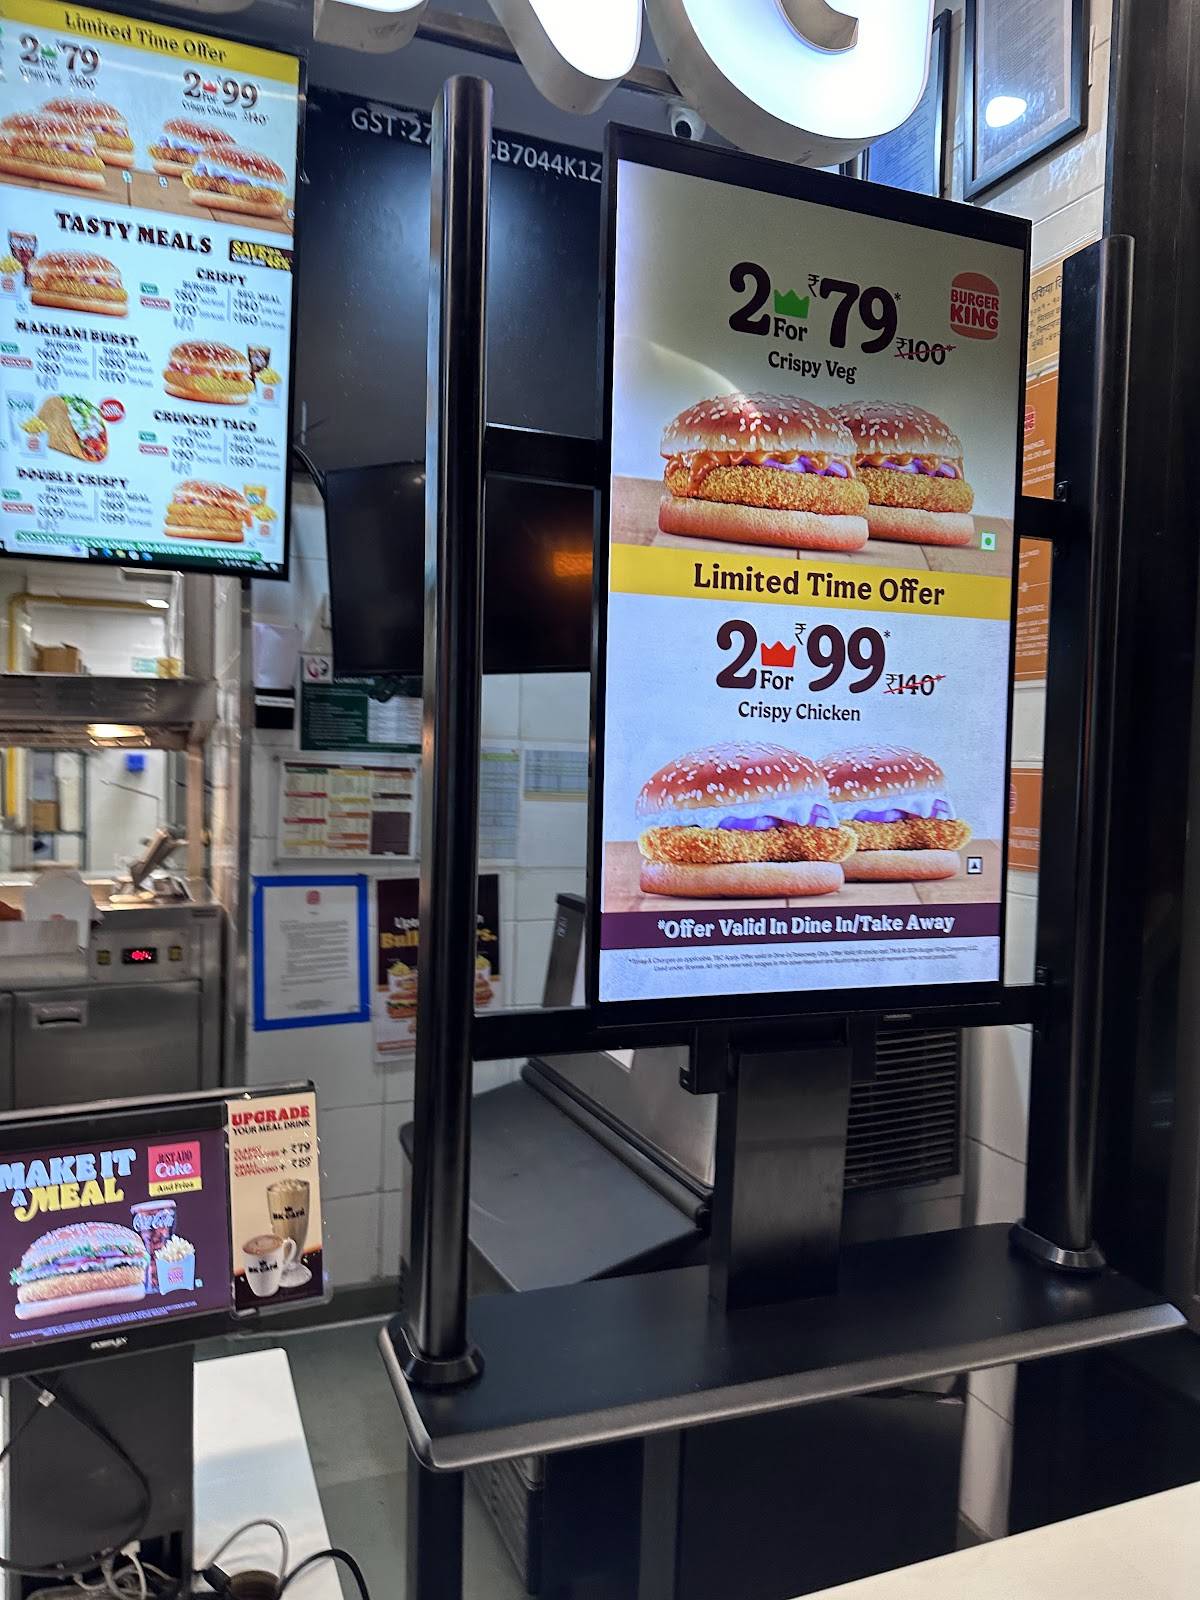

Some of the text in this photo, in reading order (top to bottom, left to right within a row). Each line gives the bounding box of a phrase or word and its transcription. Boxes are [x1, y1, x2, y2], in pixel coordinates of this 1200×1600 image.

[19, 33, 40, 64] 2
[64, 10, 228, 63] Limited Time Offer
[183, 69, 201, 98] 2
[55, 209, 213, 254] TASTY MEALS
[728, 261, 771, 337] 2
[950, 288, 1000, 311] BURGER
[773, 317, 808, 342] For
[950, 304, 1000, 331] KING
[767, 350, 857, 385] Crispy Veg
[694, 562, 946, 606] Limited Time Offer
[715, 619, 758, 690] 2
[759, 669, 795, 692] For
[737, 701, 862, 723] Crispy Chicken
[718, 916, 766, 937] Valid
[769, 916, 788, 935] In
[790, 915, 833, 935] Dine
[835, 913, 904, 935] In/Take
[905, 913, 956, 934] Away
[231, 1104, 310, 1127] UPGRADE
[232, 1119, 312, 1136] YOUR MEAL DRINK
[0, 1147, 137, 1193] MAKE IT
[155, 1161, 194, 1178] Coke
[11, 1188, 28, 1208] A
[14, 1176, 125, 1223] MEAL
